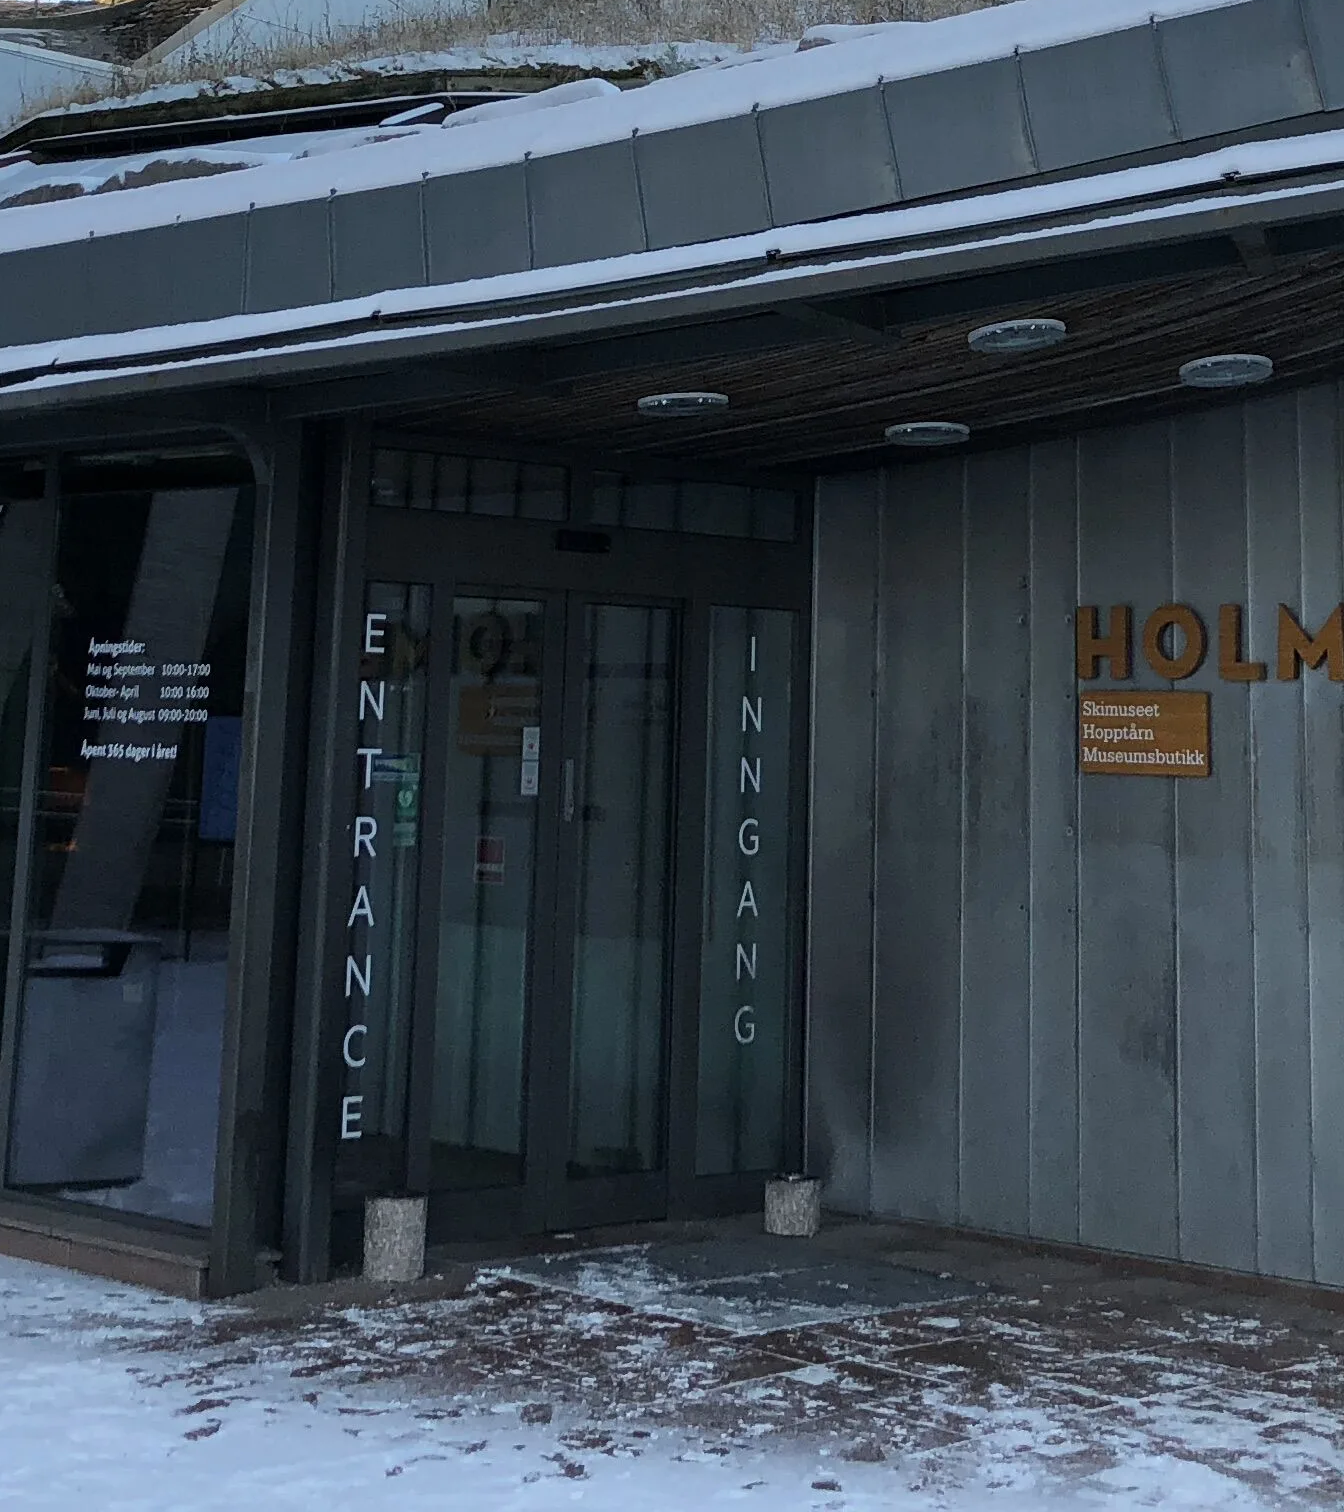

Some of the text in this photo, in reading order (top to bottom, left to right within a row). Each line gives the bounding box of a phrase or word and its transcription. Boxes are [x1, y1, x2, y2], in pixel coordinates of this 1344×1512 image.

[113, 663, 156, 679] September
[1082, 700, 1160, 717] Skimuseet
[1082, 722, 1155, 743] Hopptårn
[106, 743, 125, 759] 365
[1082, 746, 1205, 765] Museumsbutikk
[733, 635, 763, 1045] INNGANG
[340, 612, 387, 1140] ENTRANCE
